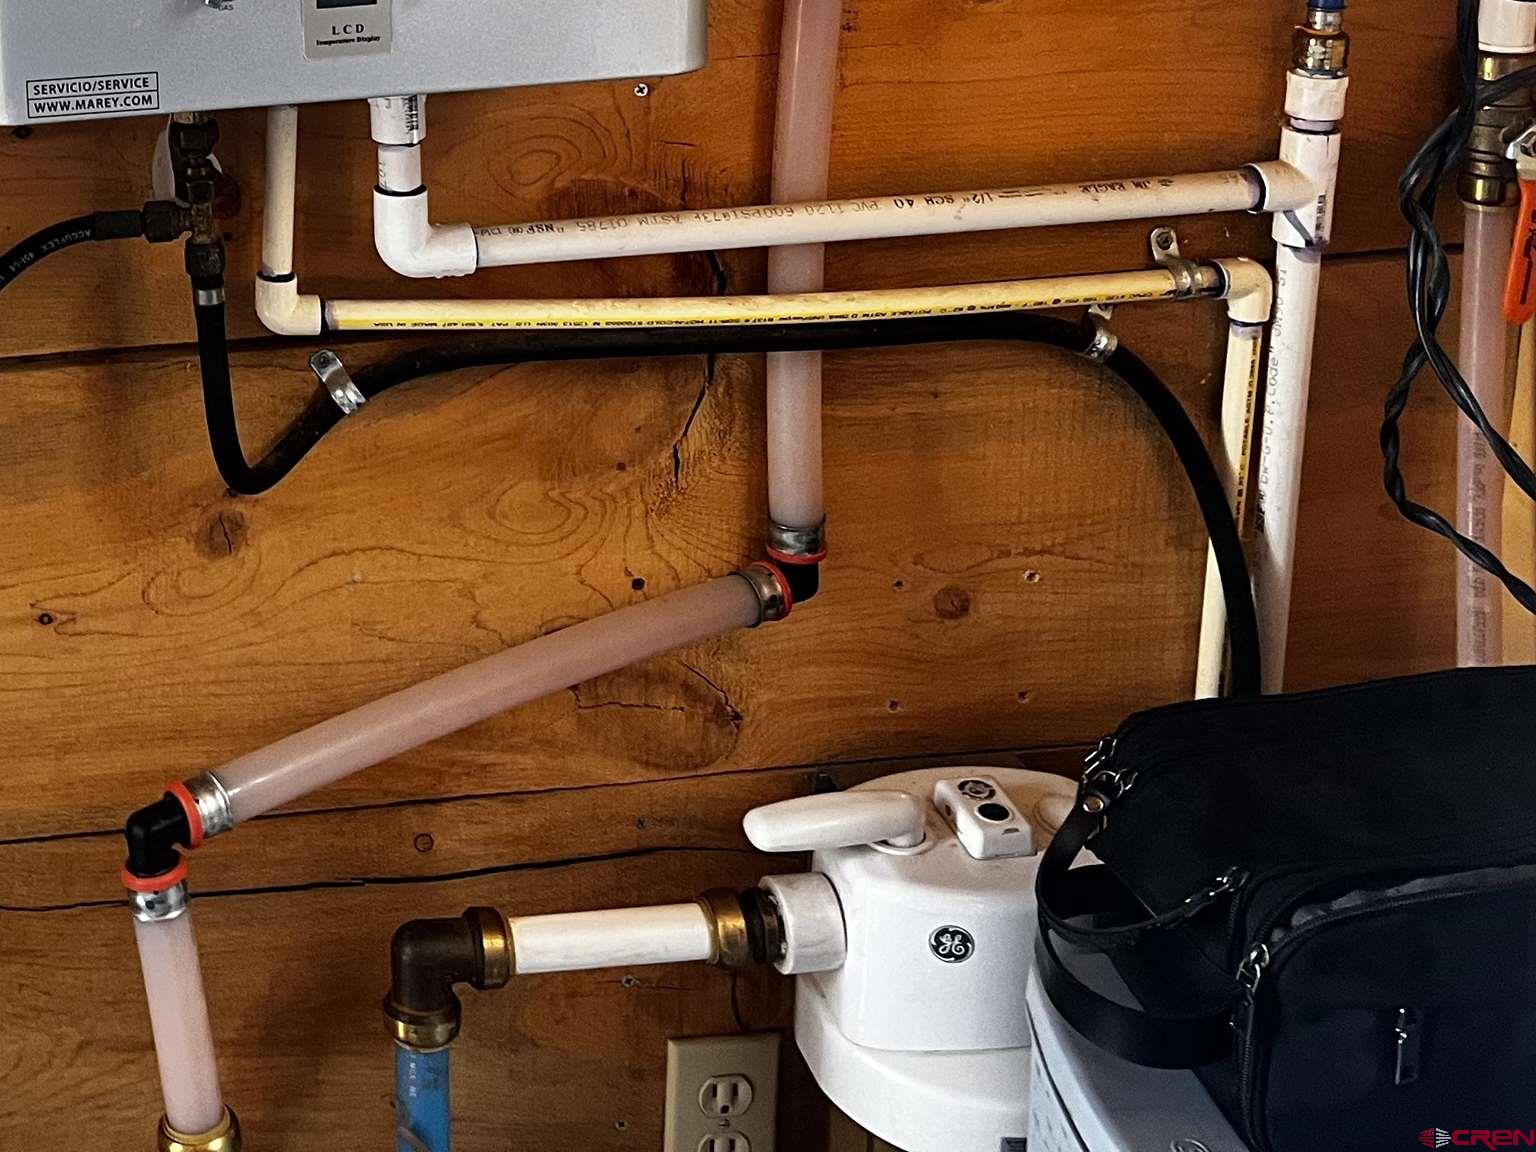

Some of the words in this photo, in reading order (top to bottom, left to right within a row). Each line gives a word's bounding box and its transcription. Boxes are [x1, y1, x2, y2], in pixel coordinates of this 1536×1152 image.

[33, 77, 150, 96] SERVICIO/SERVICE
[34, 95, 153, 114] WWW.MAREY.COM
[1077, 182, 1126, 194] EAGLE
[893, 198, 914, 209] 40
[924, 195, 954, 206] SCH
[637, 214, 681, 226] ASTM
